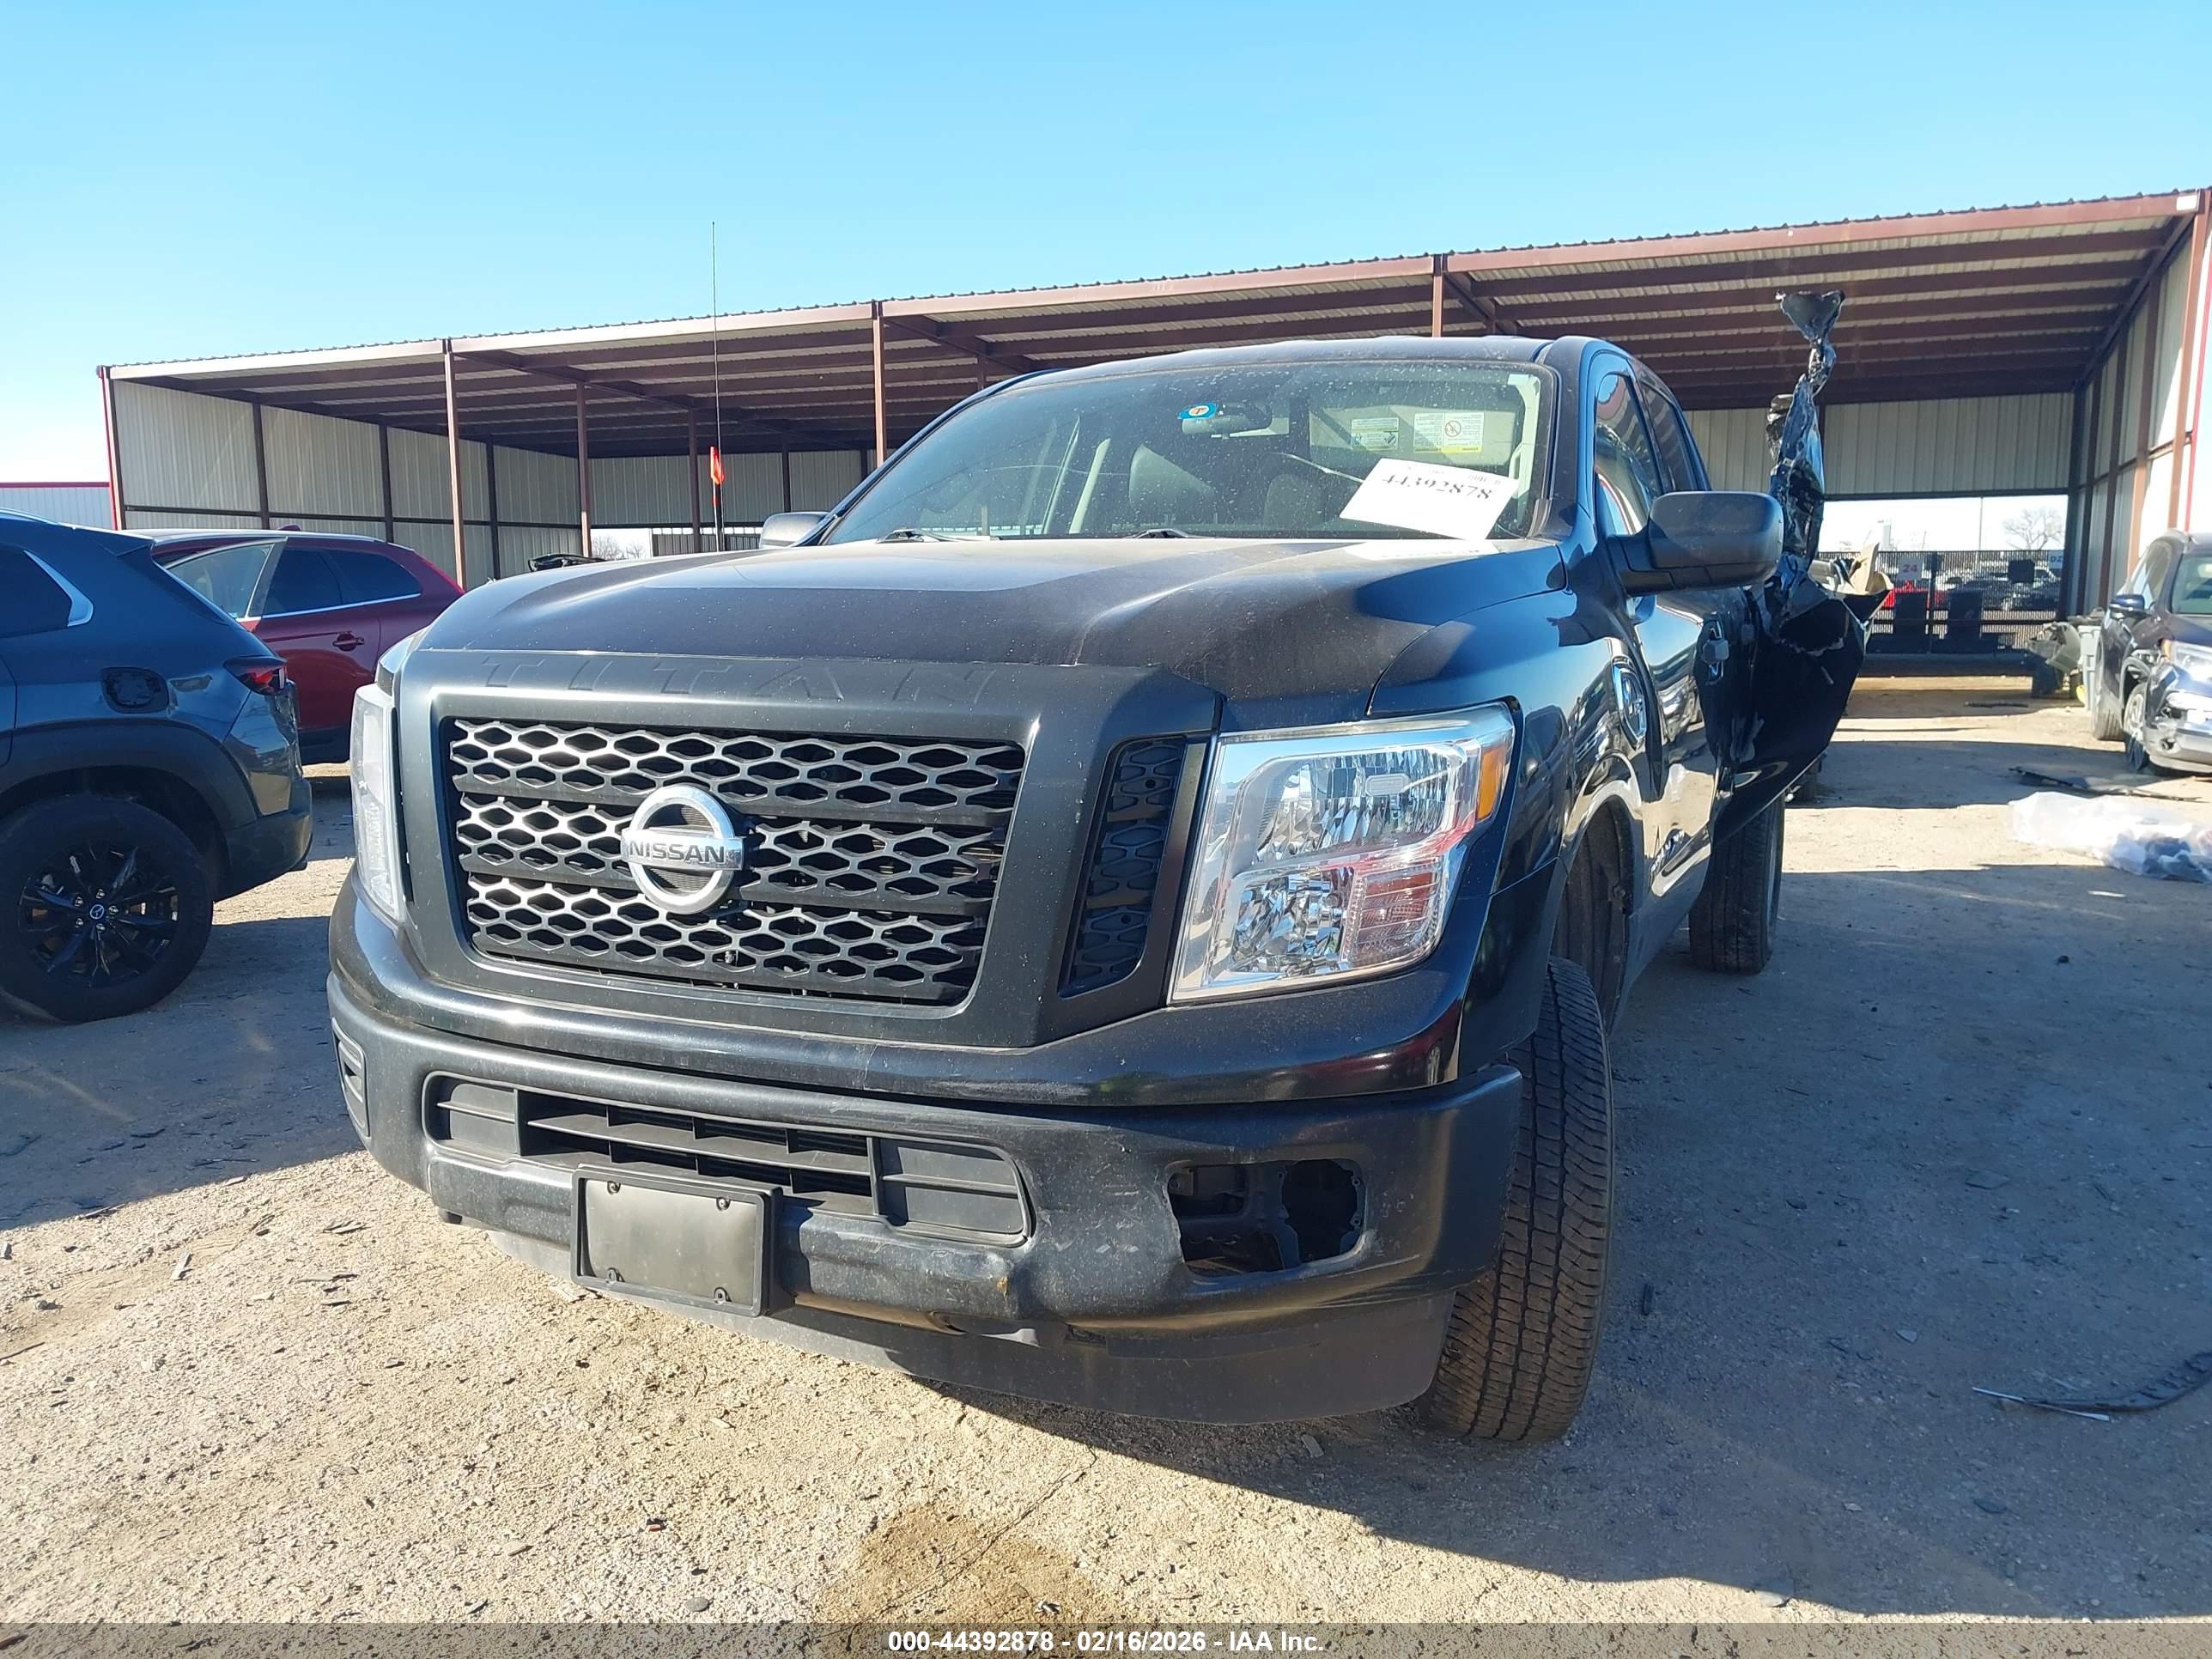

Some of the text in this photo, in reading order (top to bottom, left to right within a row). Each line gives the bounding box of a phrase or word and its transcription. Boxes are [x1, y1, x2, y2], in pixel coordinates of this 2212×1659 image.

[1382, 474, 1492, 499] 44392878
[482, 656, 997, 705] TITAN
[629, 840, 726, 865] NISSAN
